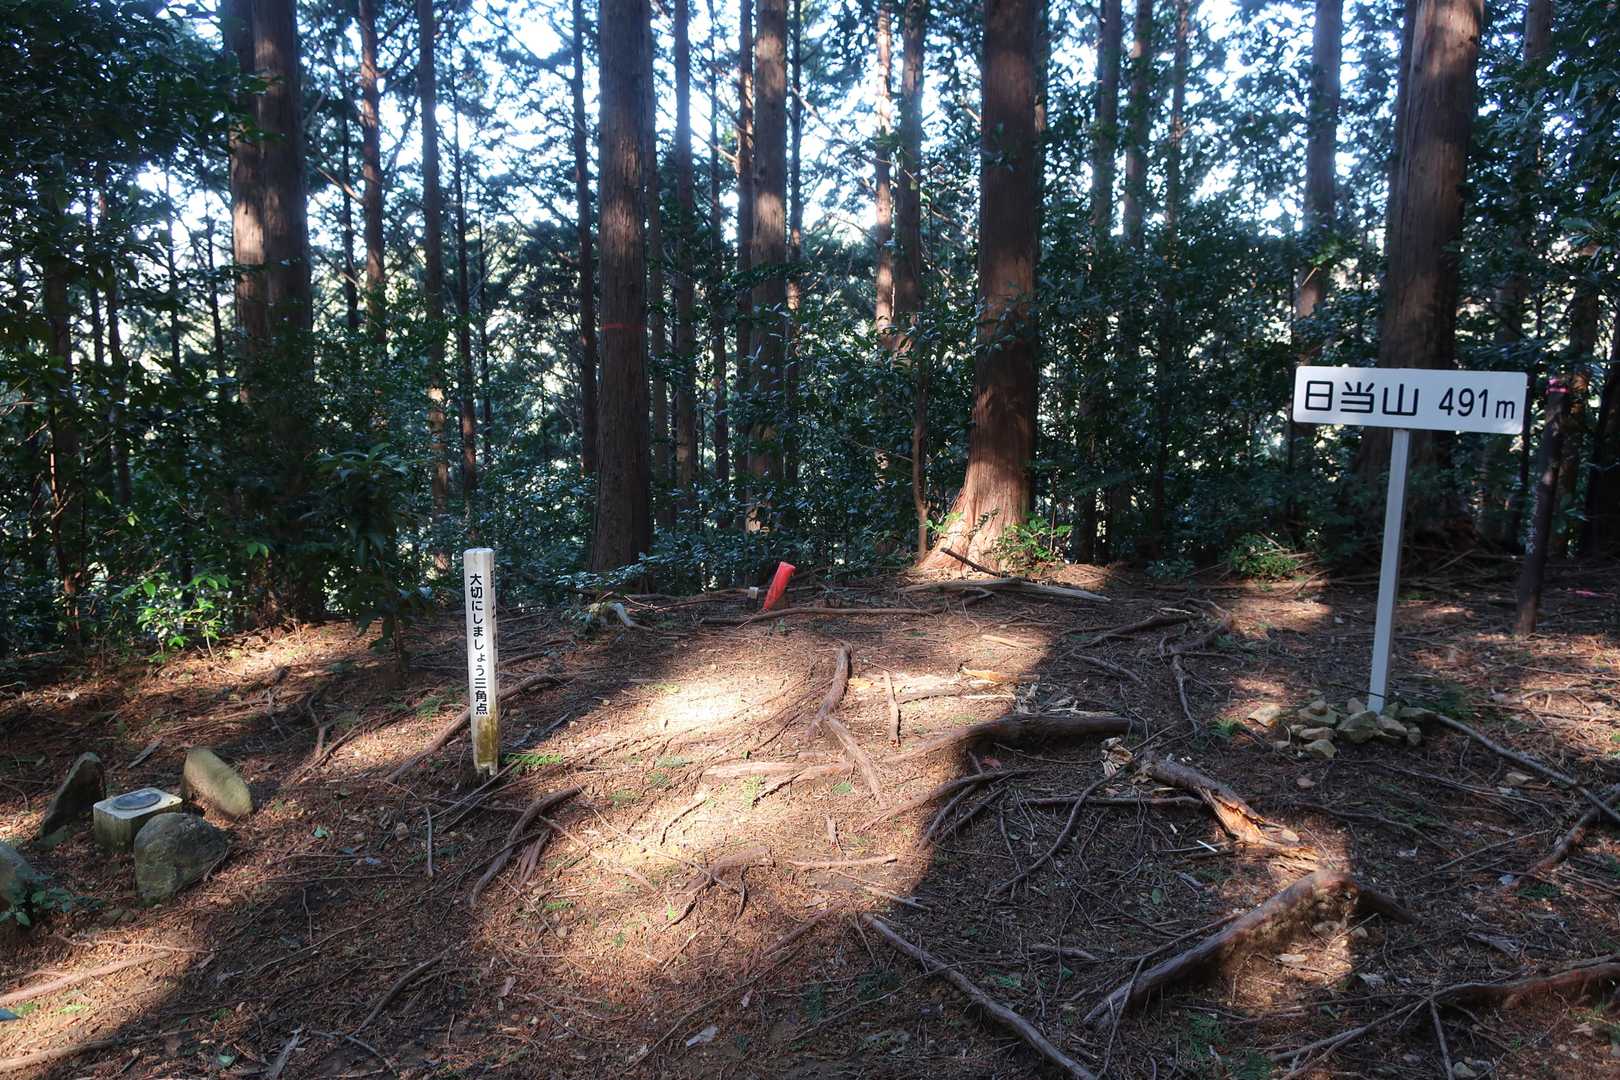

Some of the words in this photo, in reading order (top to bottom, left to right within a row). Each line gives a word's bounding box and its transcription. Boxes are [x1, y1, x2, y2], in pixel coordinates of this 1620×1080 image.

[1304, 380, 1420, 417] 日当山
[1438, 387, 1516, 420] 491m
[469, 573, 488, 715] 大切にしましょう三角点
